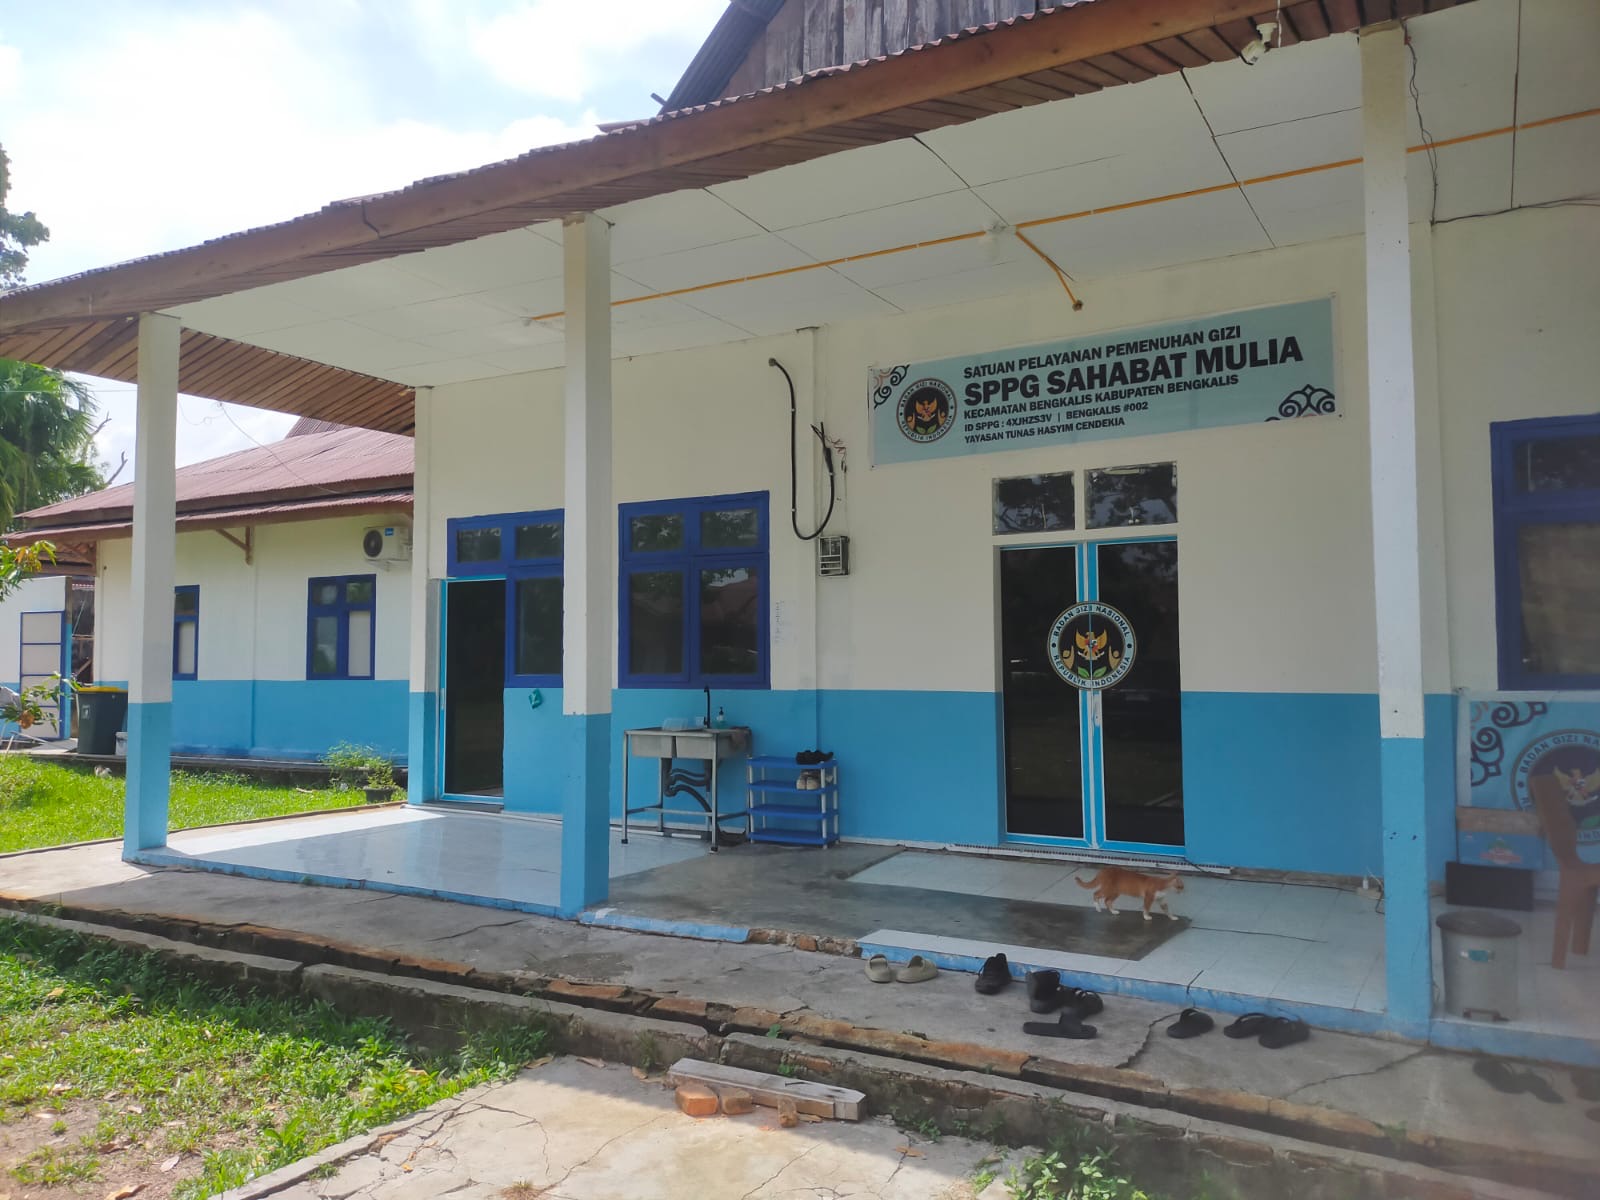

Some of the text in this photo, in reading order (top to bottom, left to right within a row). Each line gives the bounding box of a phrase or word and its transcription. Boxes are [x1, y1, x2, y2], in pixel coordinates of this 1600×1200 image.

[963, 325, 1241, 379] SATUAN PELAYANAN PEMENUHAN GIZI
[963, 336, 1304, 406] SPPG SAHABAT MULIA
[963, 374, 1239, 419] KECAMATAN BENGKALIS KABUPATEN BENGKALIS
[964, 423, 974, 432] ID
[975, 420, 1000, 431] SPPG
[1066, 405, 1121, 420] BENGKALIS
[1123, 401, 1149, 412] #002
[964, 416, 1125, 444] YAYASAN TUNAS HASYIM CENDEKIA
[1053, 610, 1074, 637] BADAN
[1095, 605, 1131, 637] NASIONAL
[1053, 654, 1130, 687] REPUBLIK INDONESIA
[1519, 741, 1550, 774] BADAN
[1552, 734, 1578, 745] GIZI
